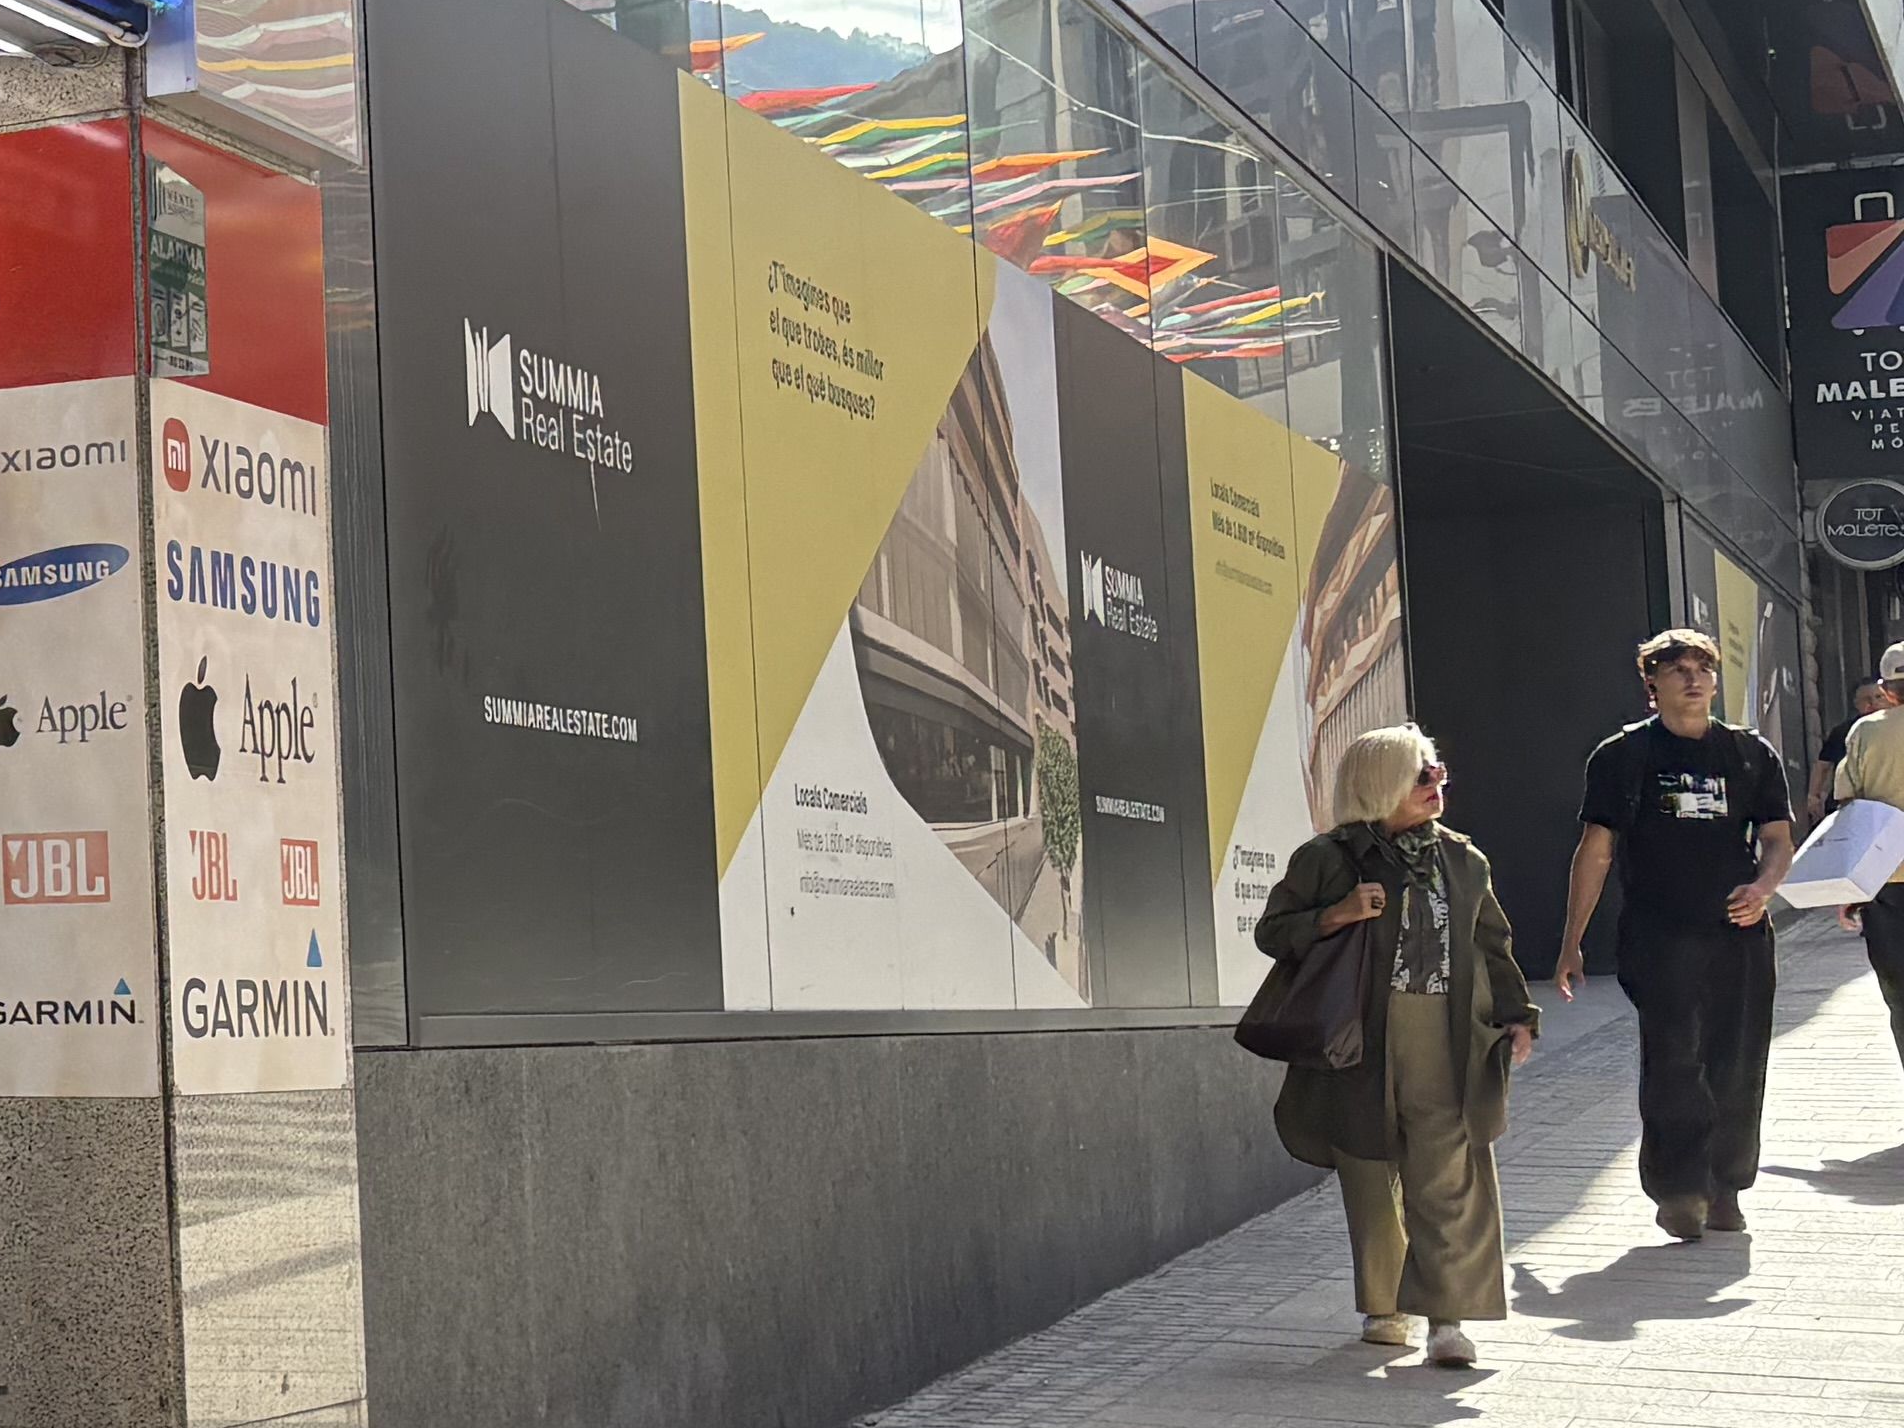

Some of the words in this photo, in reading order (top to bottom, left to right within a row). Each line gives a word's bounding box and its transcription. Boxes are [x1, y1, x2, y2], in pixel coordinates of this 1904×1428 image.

[519, 348, 604, 419] SUMMIA
[1860, 350, 1904, 373] TO
[0, 438, 128, 473] xiaomi
[522, 396, 566, 453] Real
[573, 413, 633, 474] Estate
[200, 433, 318, 517] xiaomi
[165, 539, 321, 629] SAMSUNG
[35, 693, 133, 744] Apple
[239, 674, 318, 785] Apple
[484, 694, 638, 744] SUMMIAREALESTATE.COM
[7, 838, 106, 898] JBL
[189, 828, 239, 903] JBL
[282, 841, 319, 903] JBL
[182, 976, 331, 1039] GARMIN
